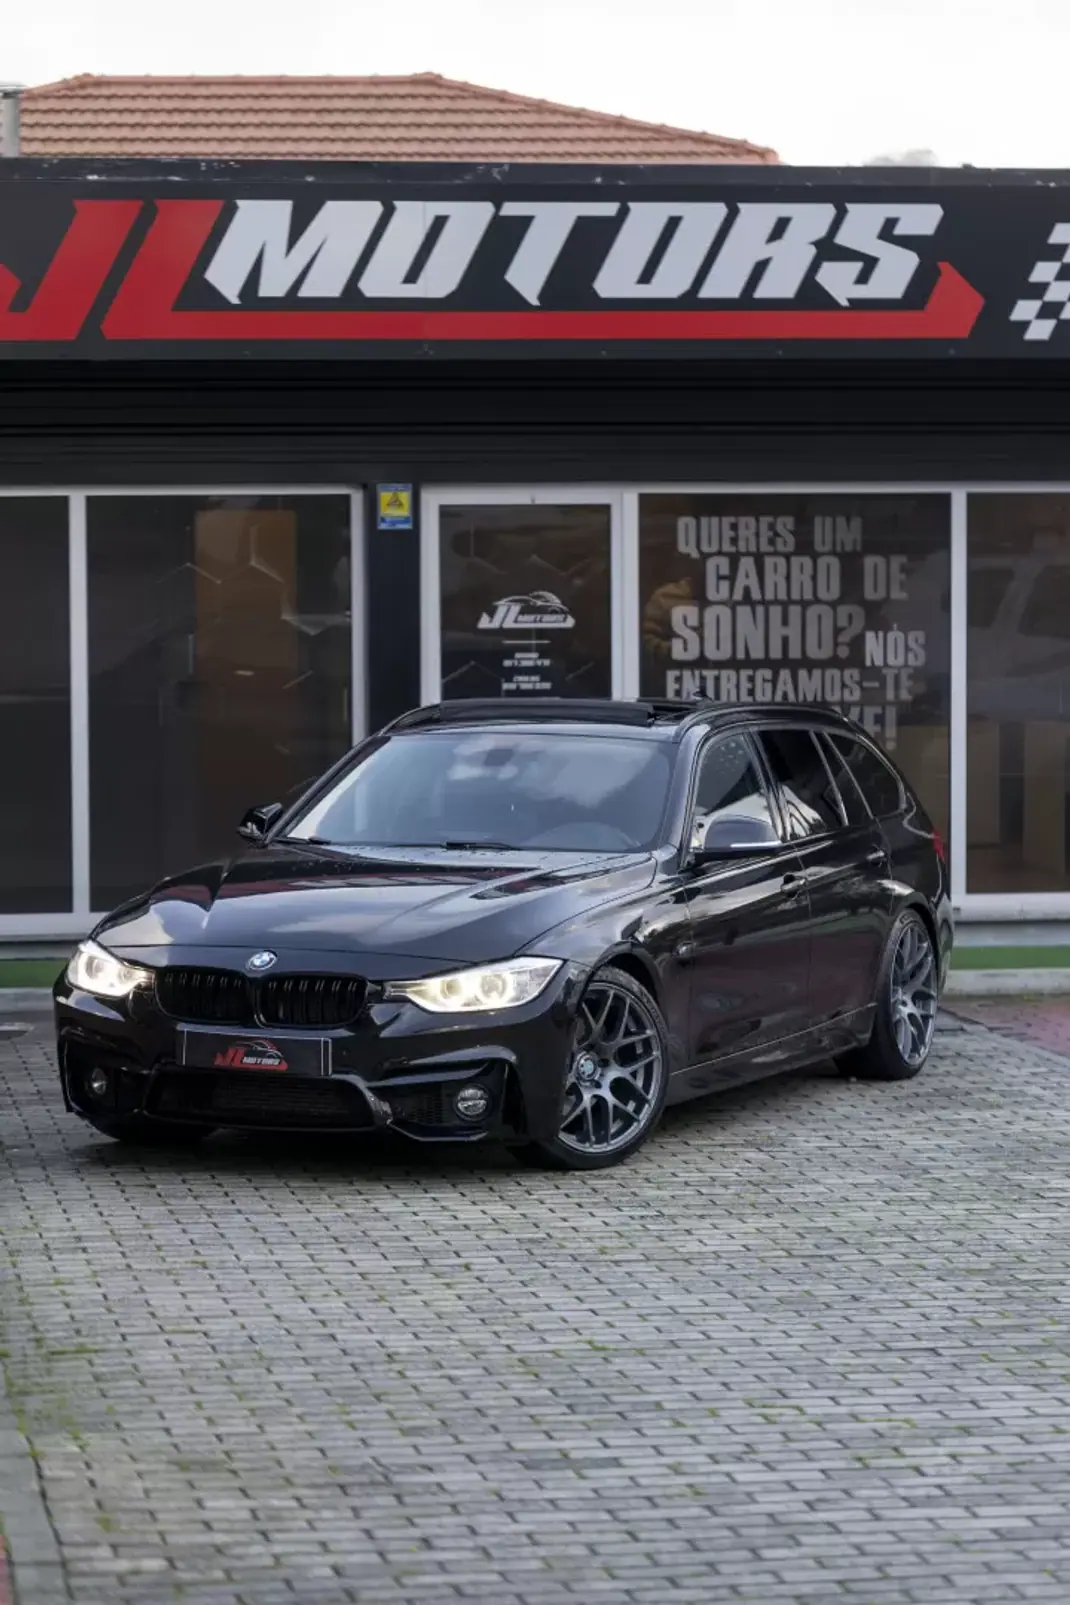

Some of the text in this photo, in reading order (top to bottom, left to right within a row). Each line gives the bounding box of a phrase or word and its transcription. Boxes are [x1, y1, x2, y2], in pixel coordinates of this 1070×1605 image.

[203, 199, 944, 307] MOTORS
[676, 515, 863, 559] QUERES UM
[705, 555, 909, 602] CARRO DE
[671, 604, 926, 667] SONHO? NÓS
[665, 667, 915, 703] ENTREGAMOS-TE
